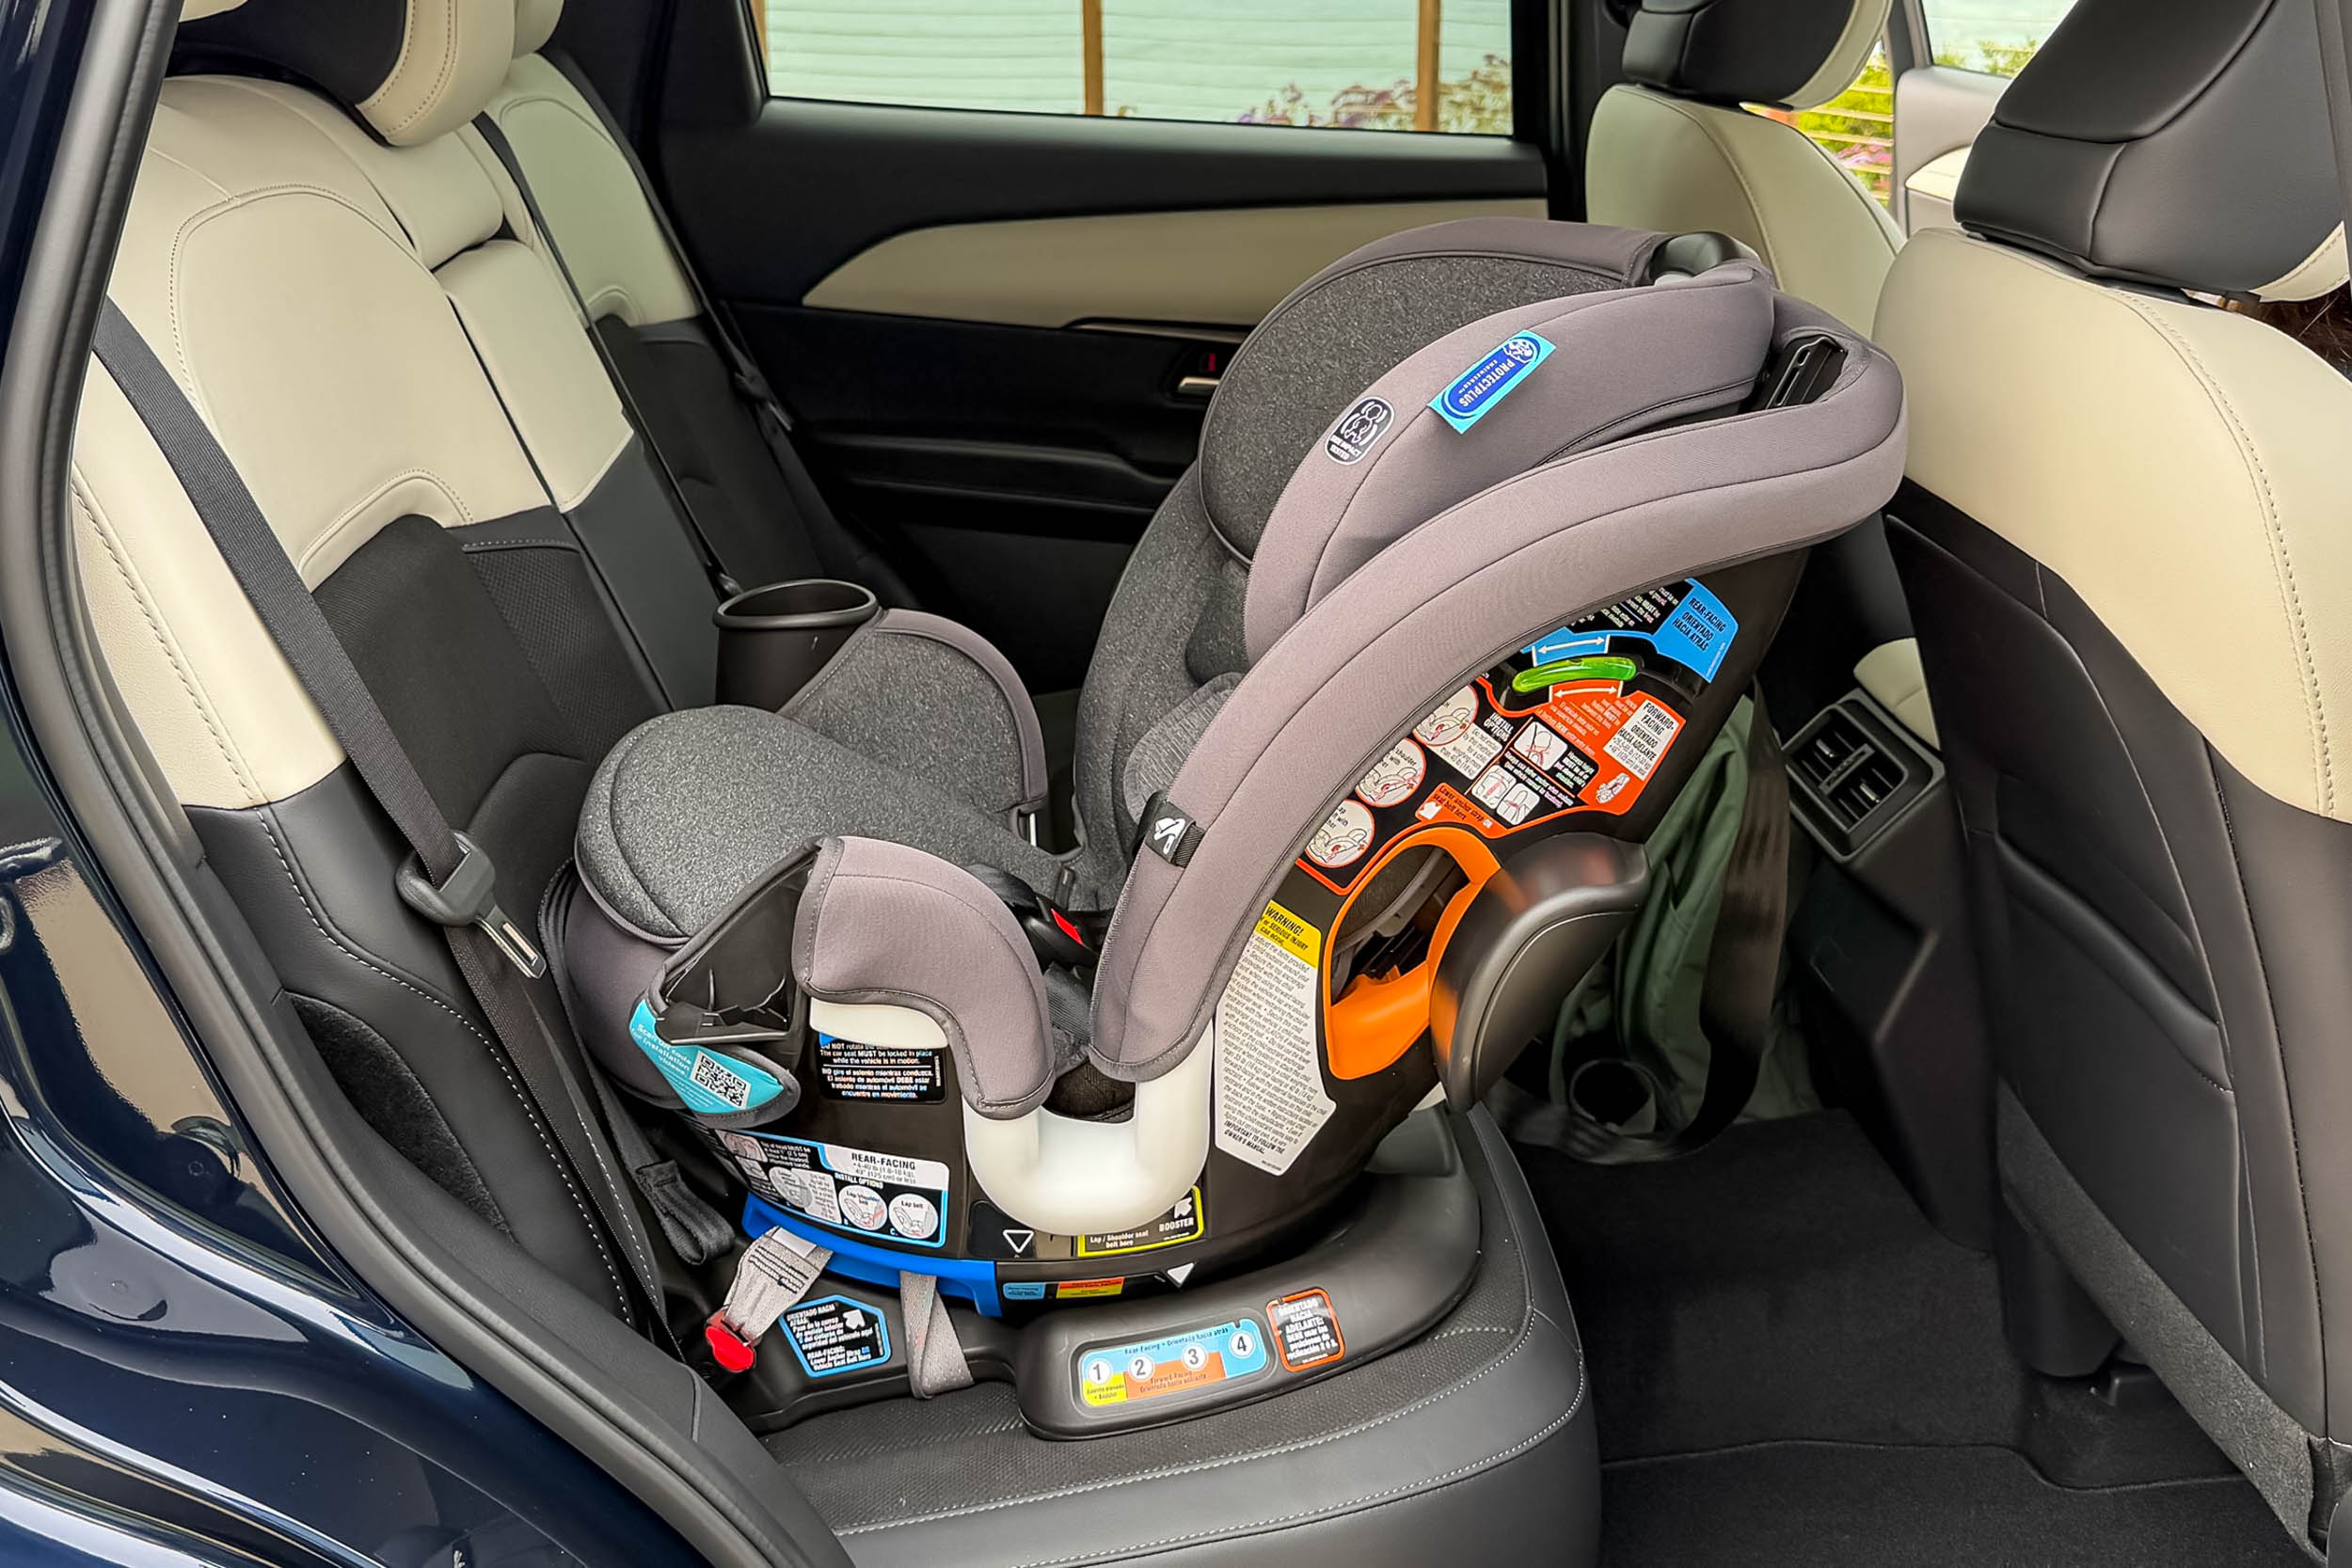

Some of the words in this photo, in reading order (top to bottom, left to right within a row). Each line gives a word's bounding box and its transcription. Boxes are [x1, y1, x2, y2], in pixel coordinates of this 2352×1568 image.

[1457, 357, 1514, 407] PROTECTPLUS
[1688, 597, 1725, 631] REAR-FACING
[1672, 618, 1691, 636] HACIA
[1680, 610, 1713, 640] ORIENTADO
[1489, 712, 1514, 733] INSTALL
[1641, 714, 1663, 735] FACING
[1644, 703, 1676, 730] FORWARD-
[1483, 719, 1509, 741] OPTIONS
[1630, 724, 1658, 748] ORIENTADO
[1618, 728, 1634, 742] HACIA
[1632, 739, 1656, 760] ADELANTE
[1433, 793, 1445, 804] seat
[1443, 800, 1455, 812] belt
[1454, 808, 1466, 819] here
[1438, 785, 1454, 800] Lower
[1454, 797, 1471, 813] anchor
[1470, 809, 1485, 823] strap
[1265, 907, 1303, 936] WARNING!
[1269, 922, 1290, 939] SERIOUS
[1289, 936, 1308, 951] INJURY
[637, 1023, 658, 1041] Scan
[657, 1039, 671, 1050] QR
[643, 1037, 690, 1070] installation
[875, 1068, 900, 1076] mientras
[1224, 1120, 1251, 1137] IMPORTANT
[1258, 1137, 1276, 1150] FOLLOW
[1275, 1146, 1284, 1154] THE
[850, 1152, 915, 1170] REAR-FACING
[857, 1177, 883, 1190] OPTIONS
[1158, 1217, 1194, 1231] BOOSTER
[1089, 1235, 1101, 1243] Lap
[1106, 1231, 1134, 1241] Shoulder
[1119, 1238, 1134, 1246] here
[1290, 1308, 1313, 1322] HACIA
[1235, 1336, 1248, 1352] 4
[1187, 1347, 1200, 1365] 3
[1091, 1364, 1102, 1381] 1
[1134, 1358, 1146, 1376] 2
